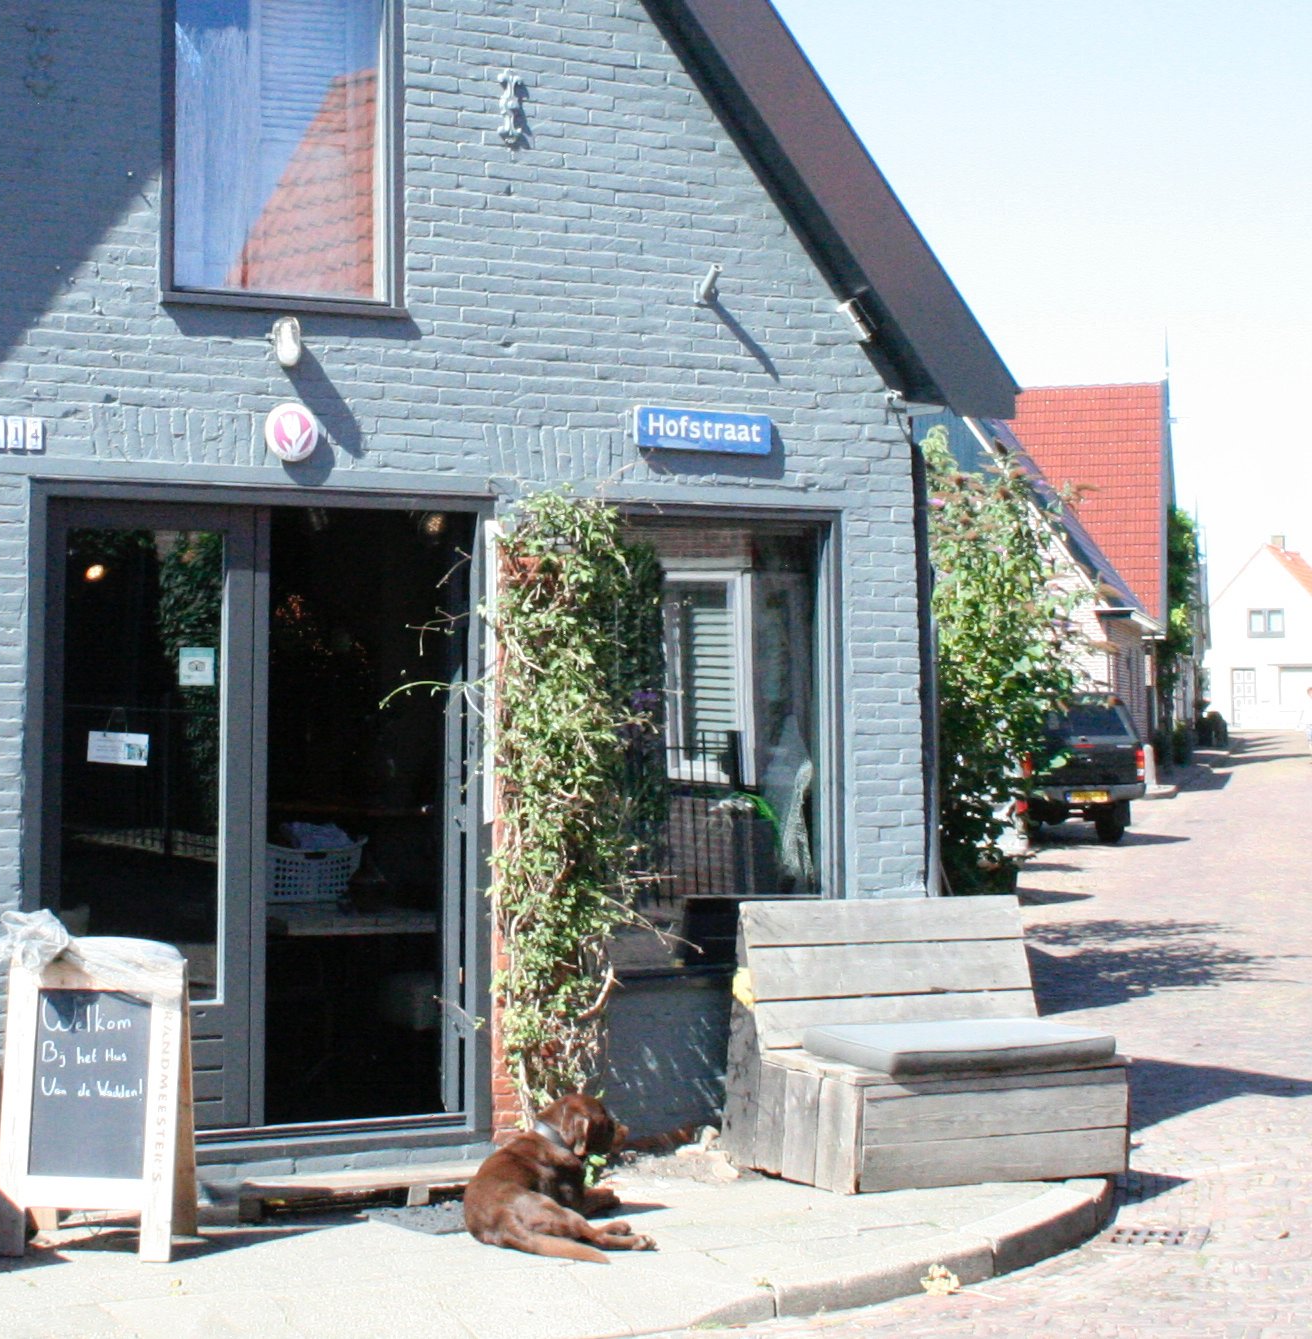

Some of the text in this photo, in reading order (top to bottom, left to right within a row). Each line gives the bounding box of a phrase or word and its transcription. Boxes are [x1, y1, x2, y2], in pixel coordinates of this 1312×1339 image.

[648, 413, 761, 443] Hofstraat
[43, 997, 132, 1033] Welkom
[77, 1046, 97, 1064] het
[77, 1082, 91, 1097] de
[151, 1003, 174, 1182] RANDMEESTER'S
